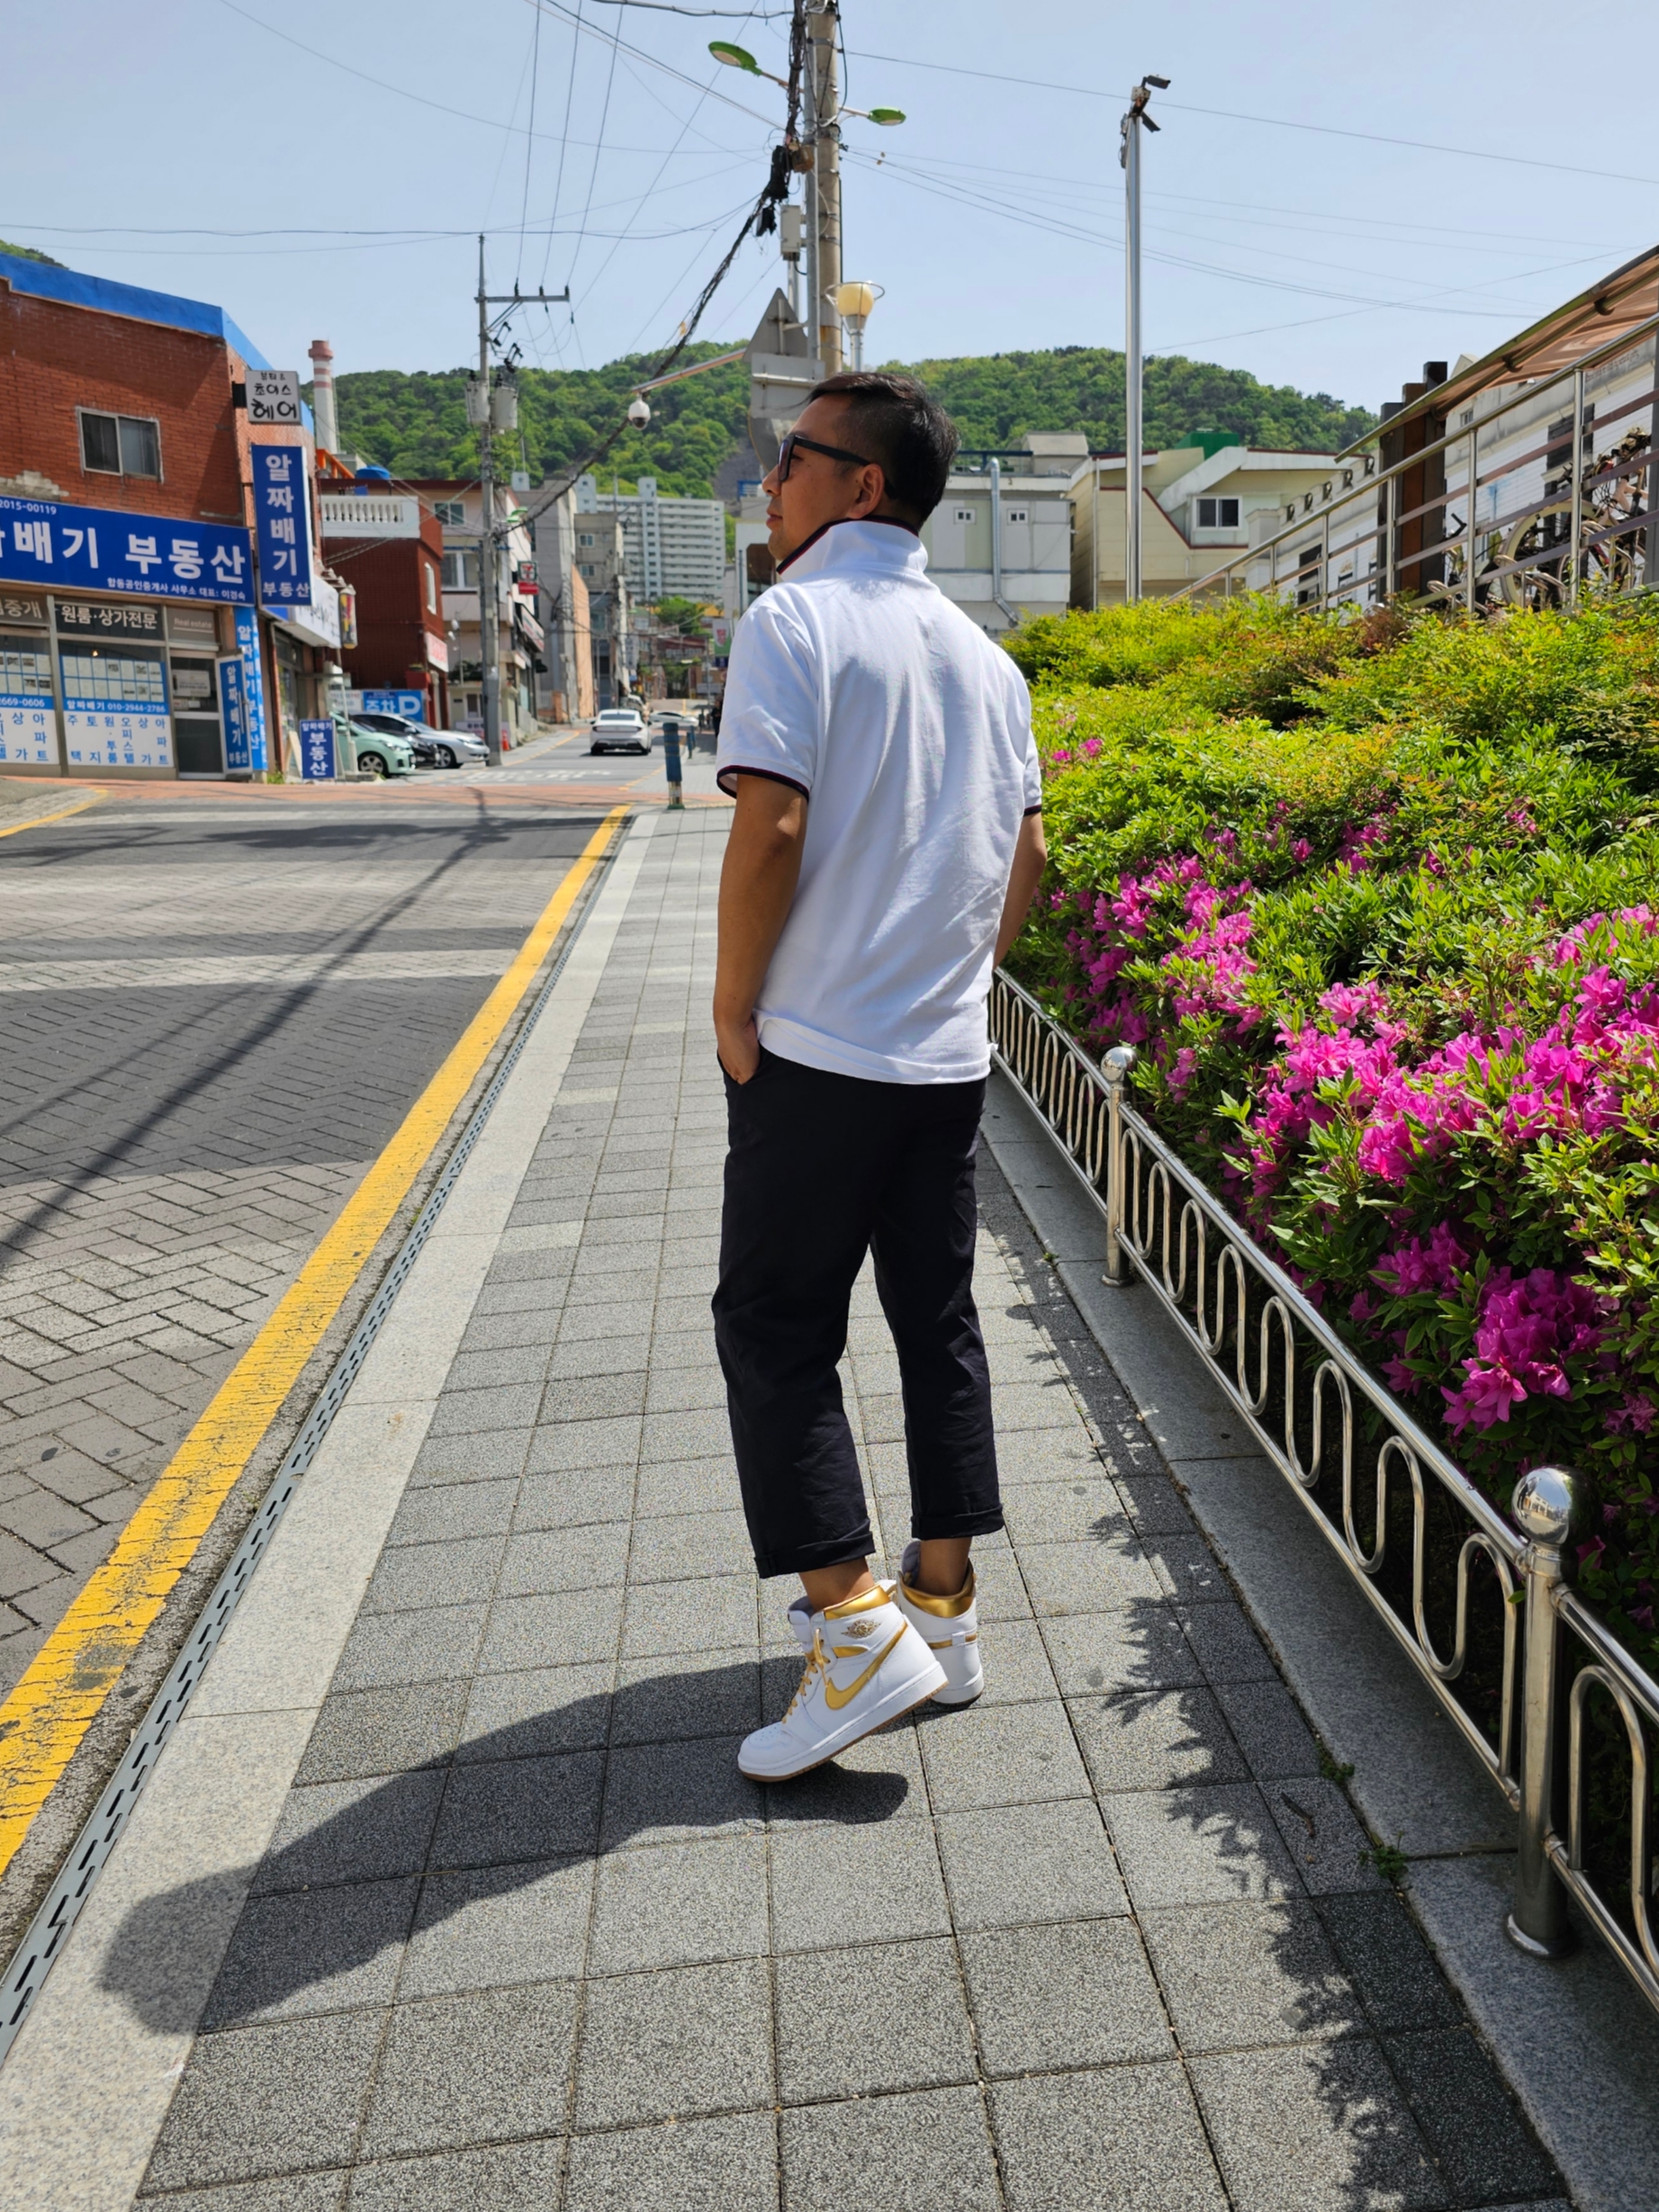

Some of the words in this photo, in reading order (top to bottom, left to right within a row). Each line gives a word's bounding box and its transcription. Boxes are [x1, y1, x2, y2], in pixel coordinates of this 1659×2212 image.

[254, 382, 292, 395] 초이스
[251, 398, 297, 420] 헤어
[266, 454, 297, 576] 알짜배기
[125, 534, 246, 584] 부동산
[171, 584, 196, 596] 사무소
[263, 582, 310, 598] 부동산
[0, 598, 42, 619] 중개
[0, 697, 45, 707] 669-0606
[68, 700, 105, 711] 알짜배기
[227, 665, 242, 746] 알짜배기
[32, 713, 49, 761] 아파트
[308, 732, 329, 776] 부동산
